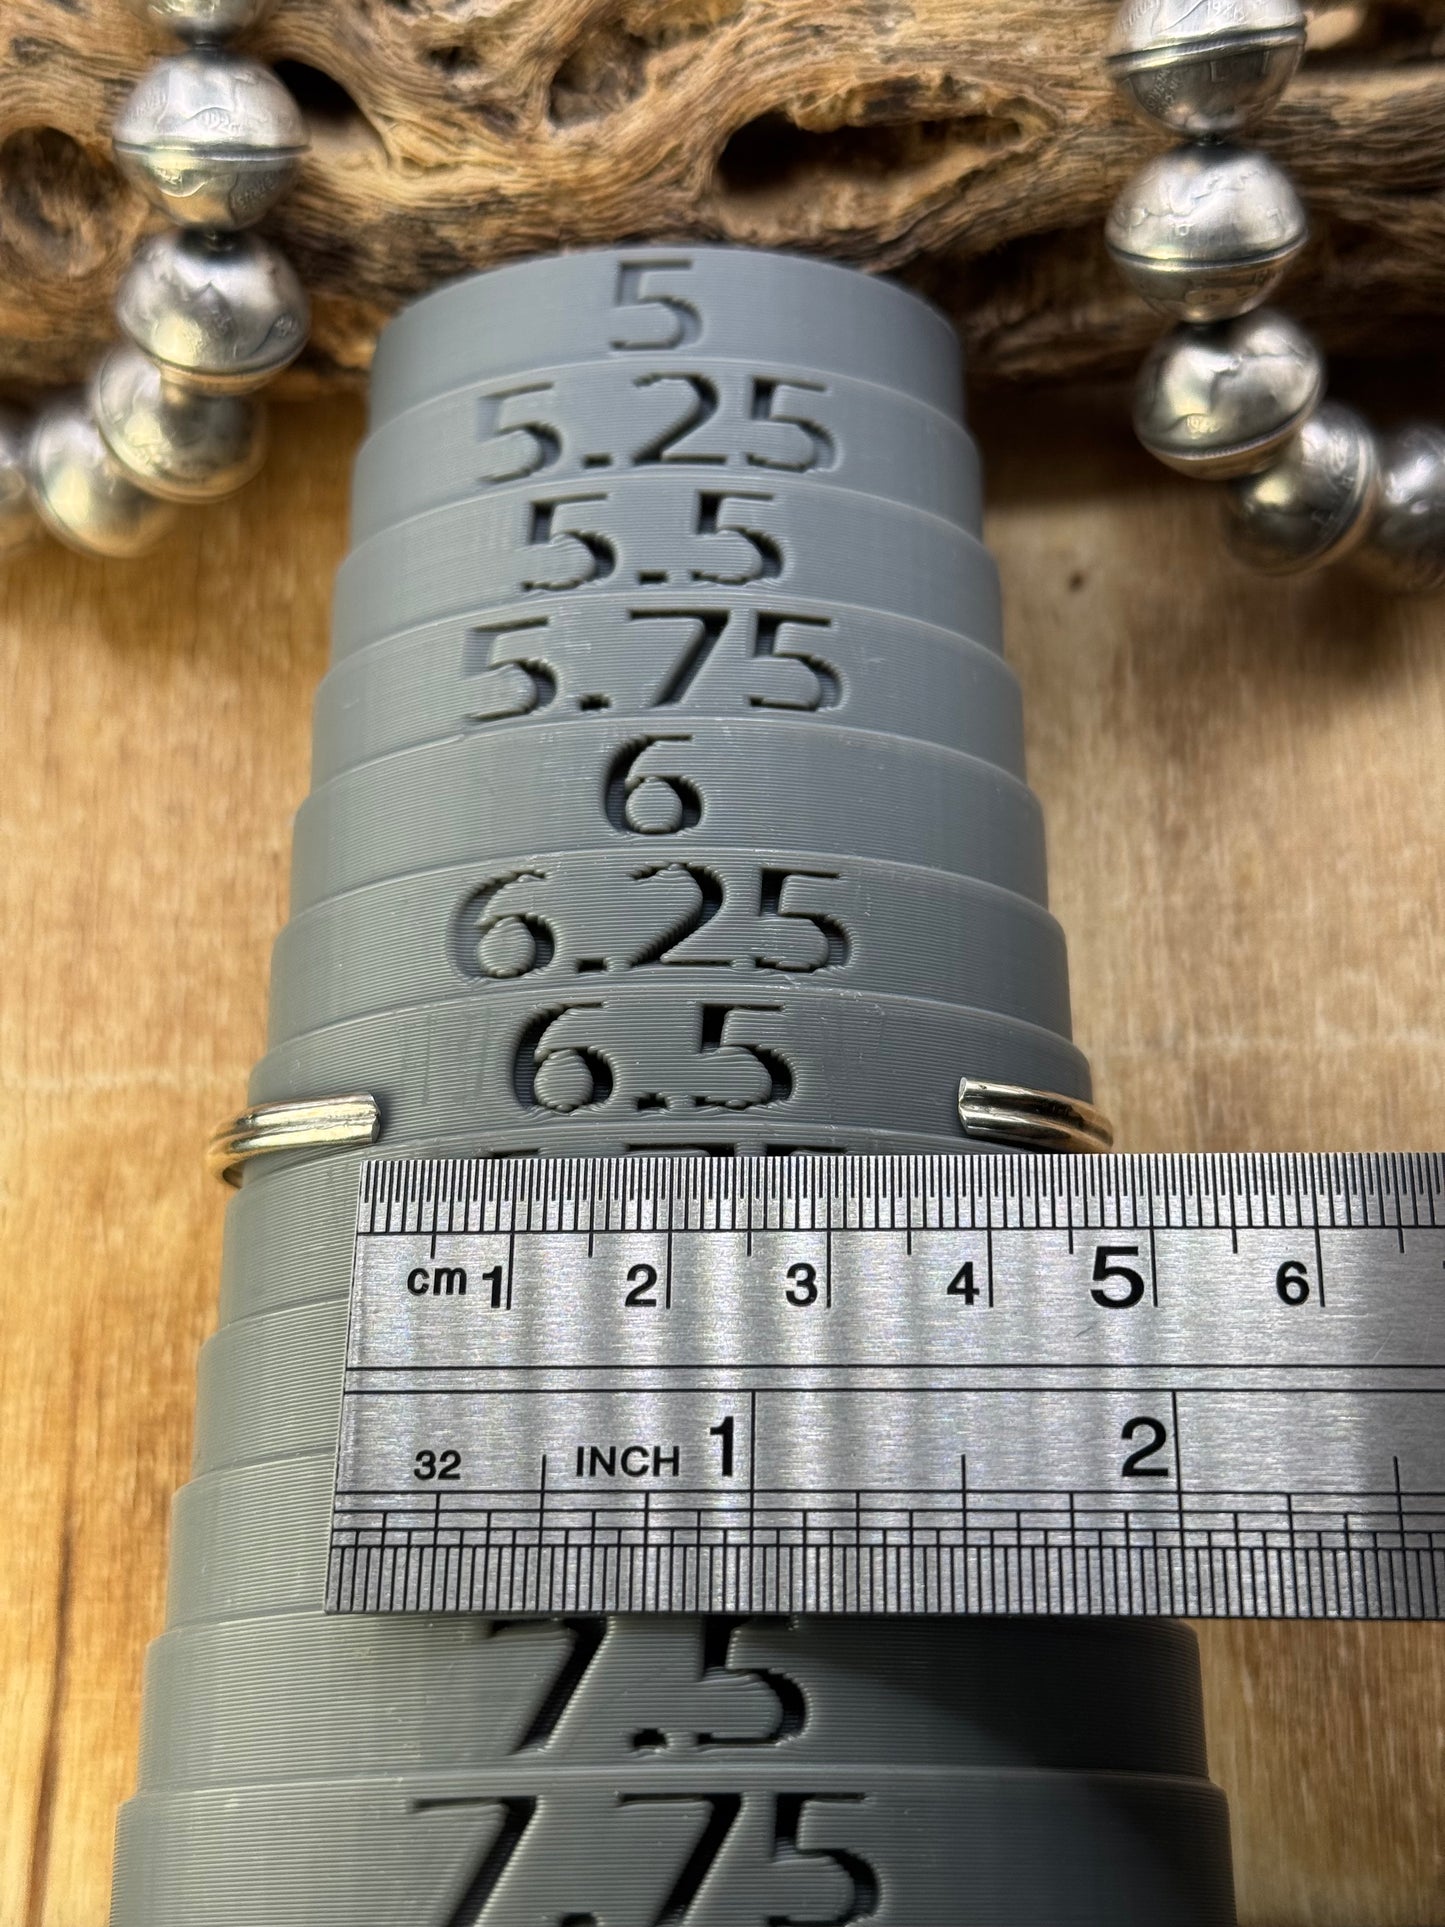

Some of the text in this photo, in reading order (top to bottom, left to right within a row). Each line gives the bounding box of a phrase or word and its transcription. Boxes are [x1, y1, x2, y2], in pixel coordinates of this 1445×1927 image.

[609, 258, 703, 351] 5
[476, 372, 842, 484] 5.25
[519, 491, 789, 592] 5.5
[461, 608, 849, 722] 5.75
[603, 734, 707, 837] 6
[447, 862, 857, 985] 6.25
[509, 1001, 800, 1115] 6.5
[406, 1245, 1311, 1309] cm 1 2 3 4 5 6
[413, 1415, 1170, 1481] 32 INCH 1 2
[487, 1614, 815, 1756] 7.5
[407, 1791, 886, 1927] 7.75
